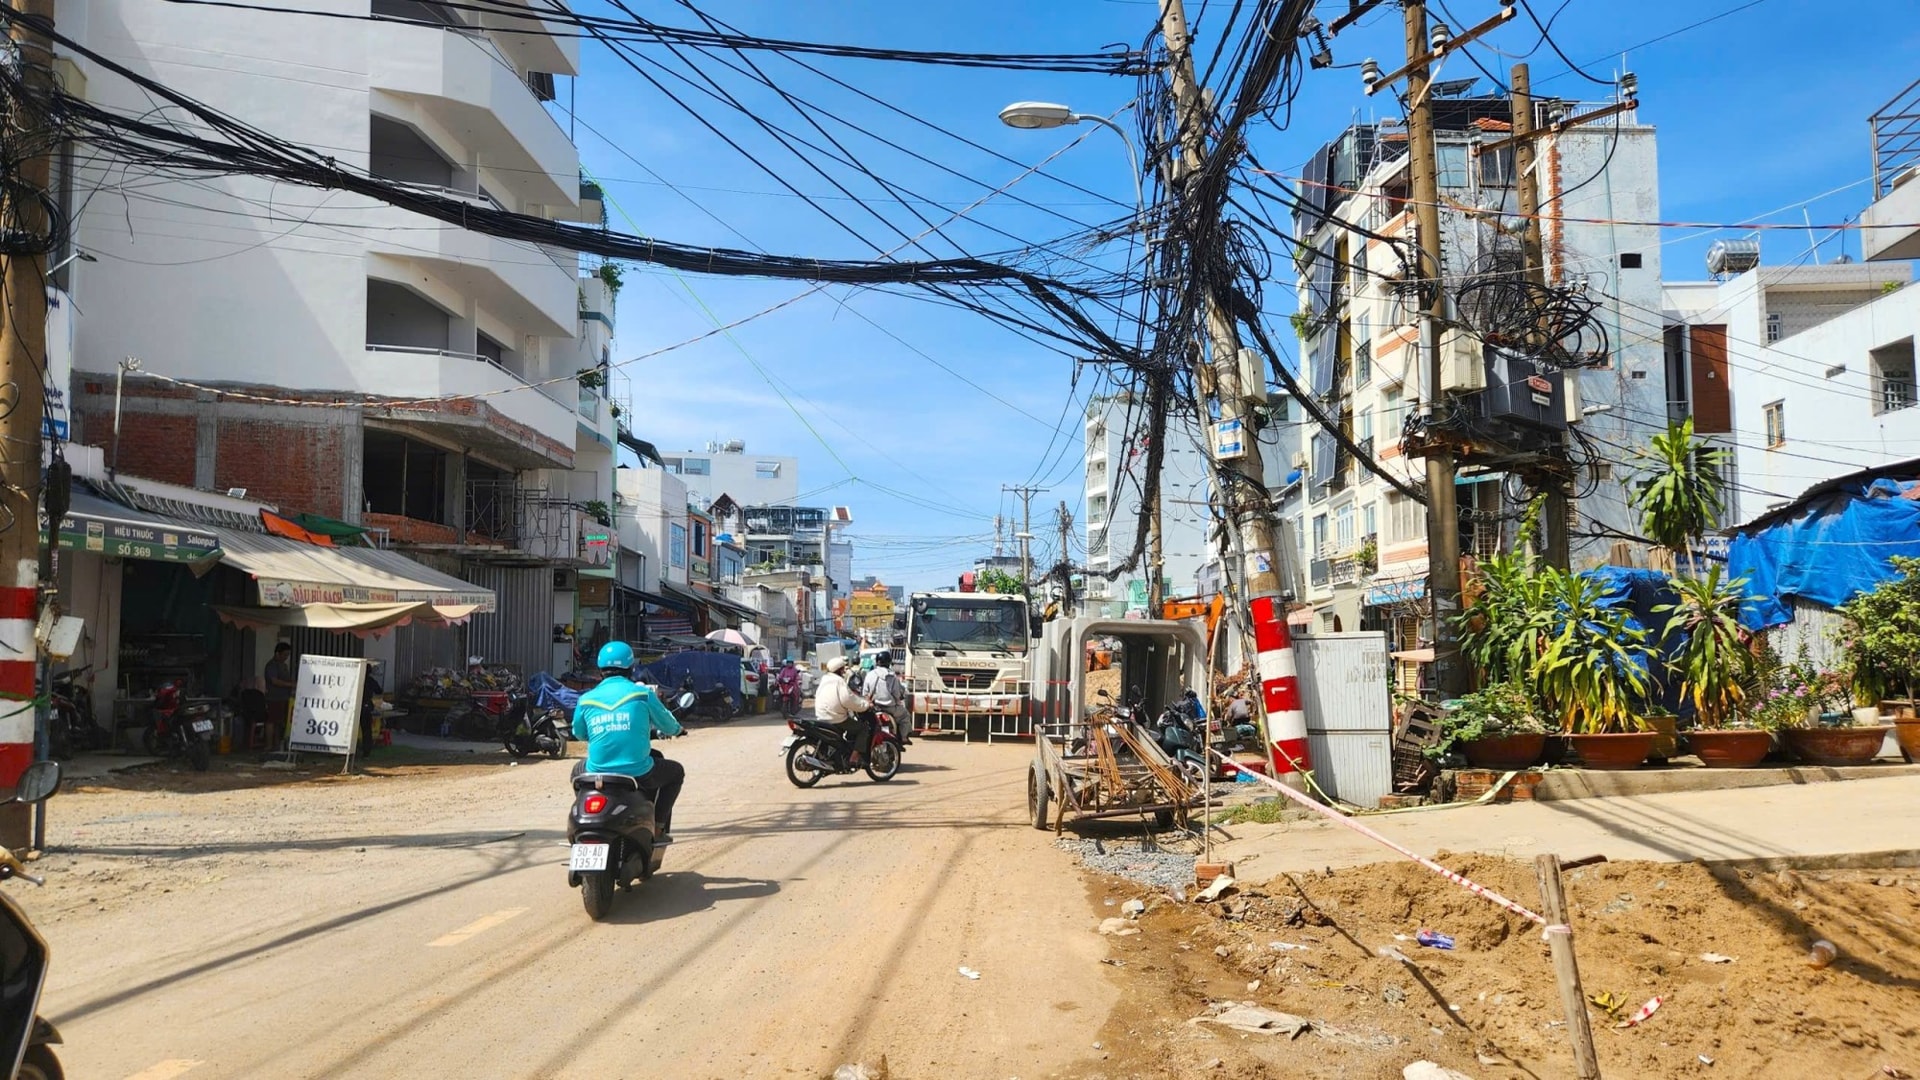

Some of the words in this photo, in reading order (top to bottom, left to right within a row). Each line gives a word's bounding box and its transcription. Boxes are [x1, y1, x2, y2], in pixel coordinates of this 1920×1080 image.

[114, 526, 131, 538] HIỆU
[132, 528, 154, 540] THUỐC
[186, 534, 216, 548] Salonpas
[117, 541, 131, 555] SỐ
[133, 547, 151, 558] 369
[941, 660, 997, 668] DAEWOO
[312, 673, 346, 689] HIỆU
[303, 696, 350, 712] THUỐC
[306, 718, 339, 737] 369
